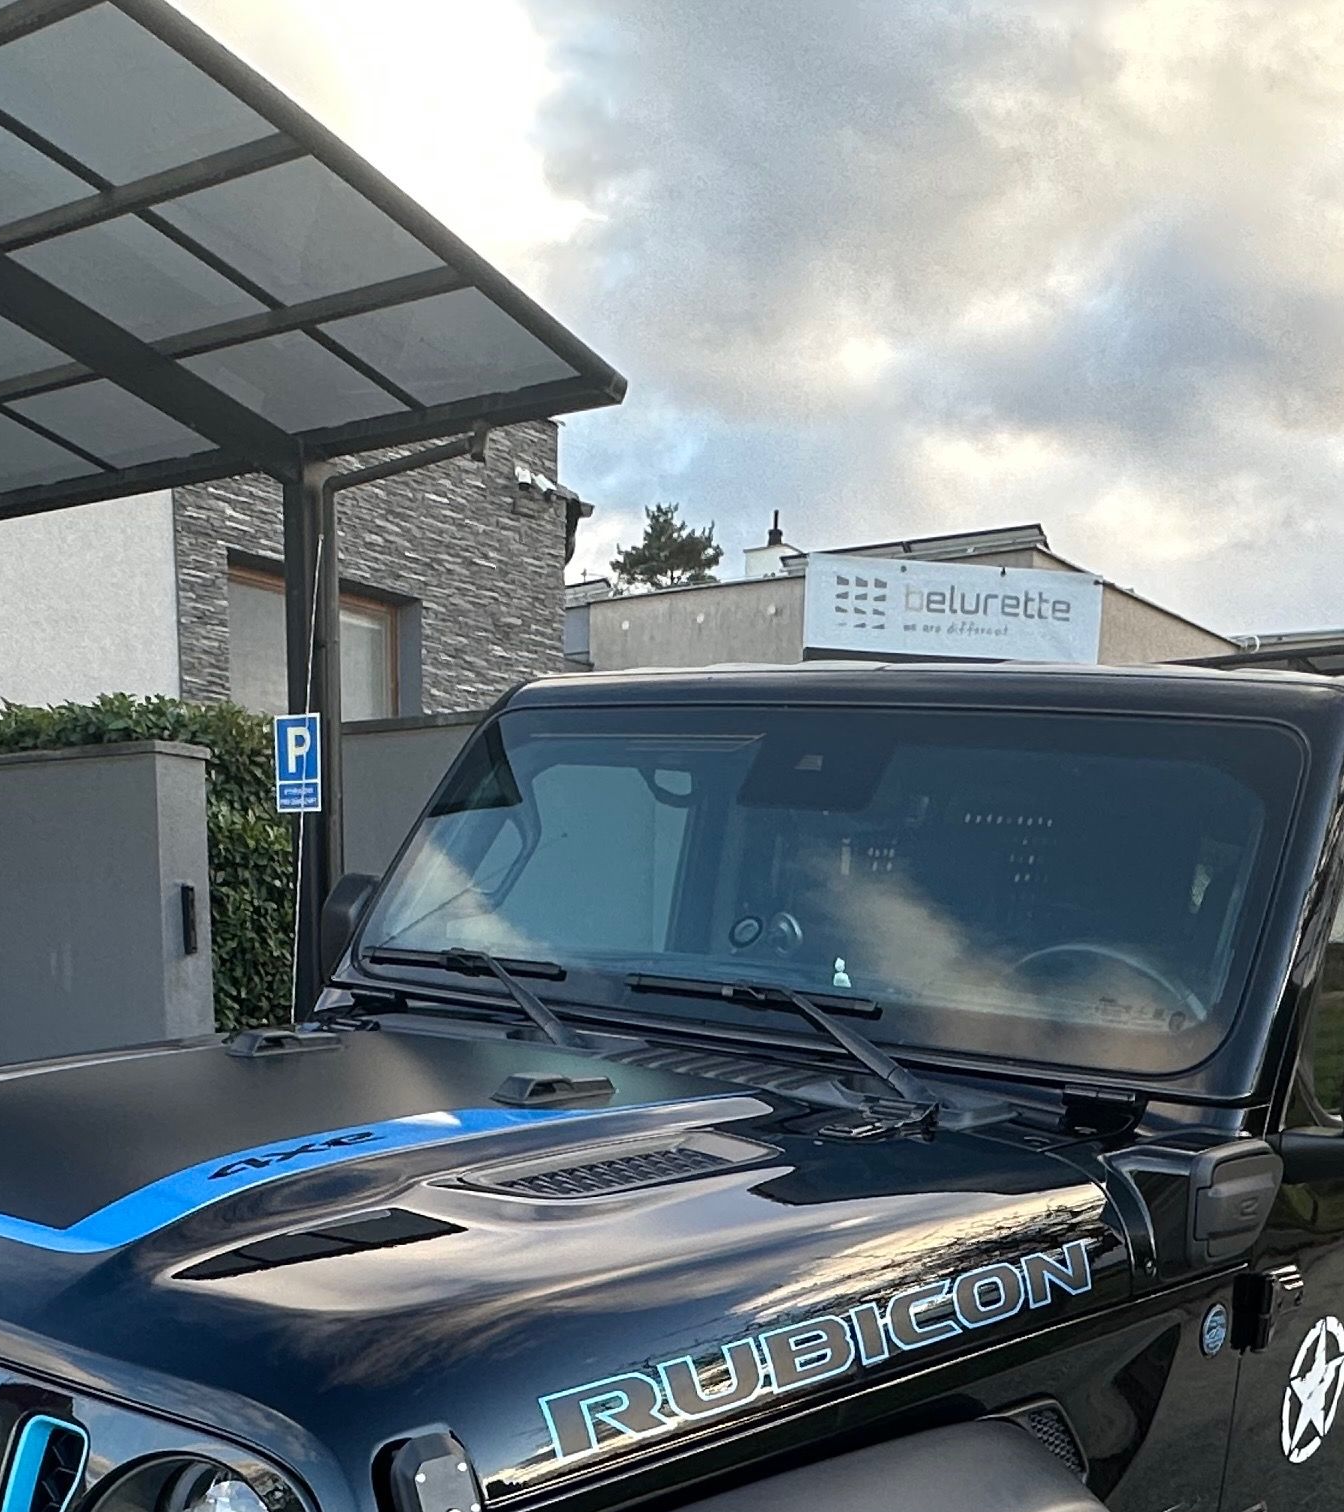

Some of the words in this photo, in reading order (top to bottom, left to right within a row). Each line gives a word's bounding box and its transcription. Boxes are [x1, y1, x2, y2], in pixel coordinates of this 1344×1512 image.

[906, 584, 1070, 622] belurette
[287, 727, 311, 773] P
[538, 1238, 1096, 1460] RUBICON
